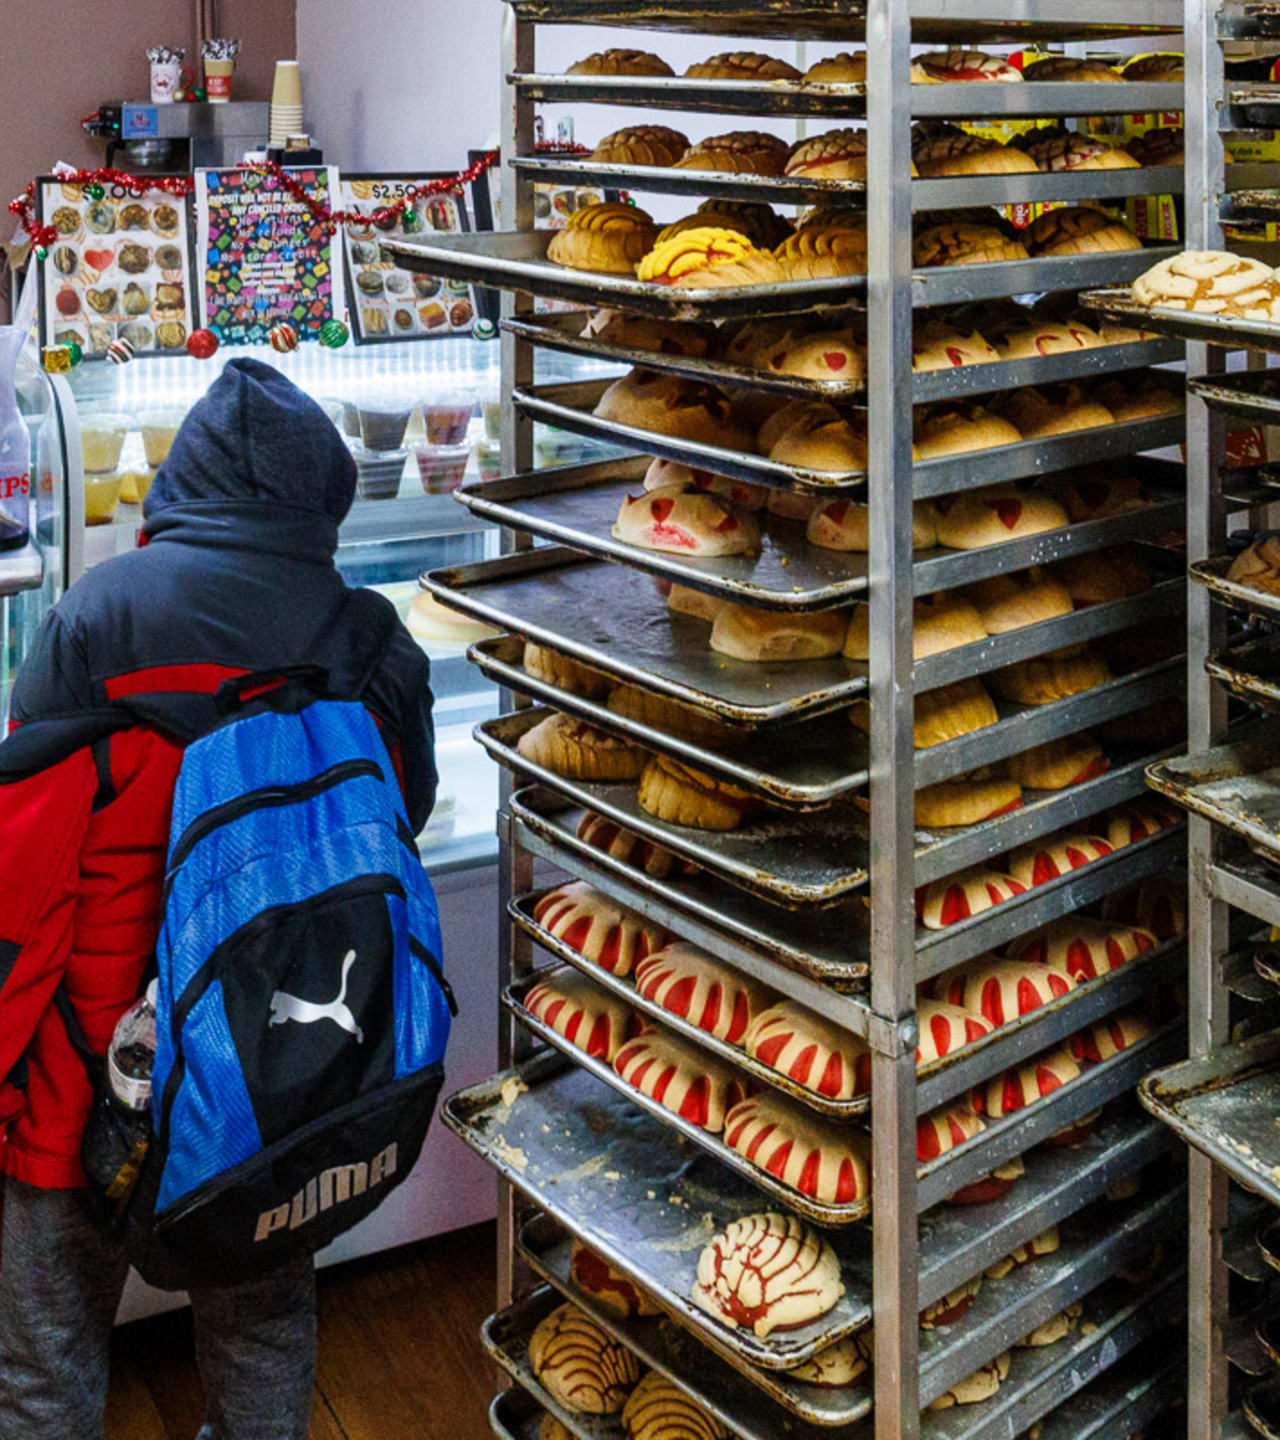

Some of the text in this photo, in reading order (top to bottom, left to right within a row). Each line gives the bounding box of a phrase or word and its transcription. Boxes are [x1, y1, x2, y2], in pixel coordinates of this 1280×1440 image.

[372, 183, 417, 199] $2.50
[259, 214, 302, 224] returns
[279, 247, 318, 259] credit
[253, 1141, 397, 1242] PUMA
